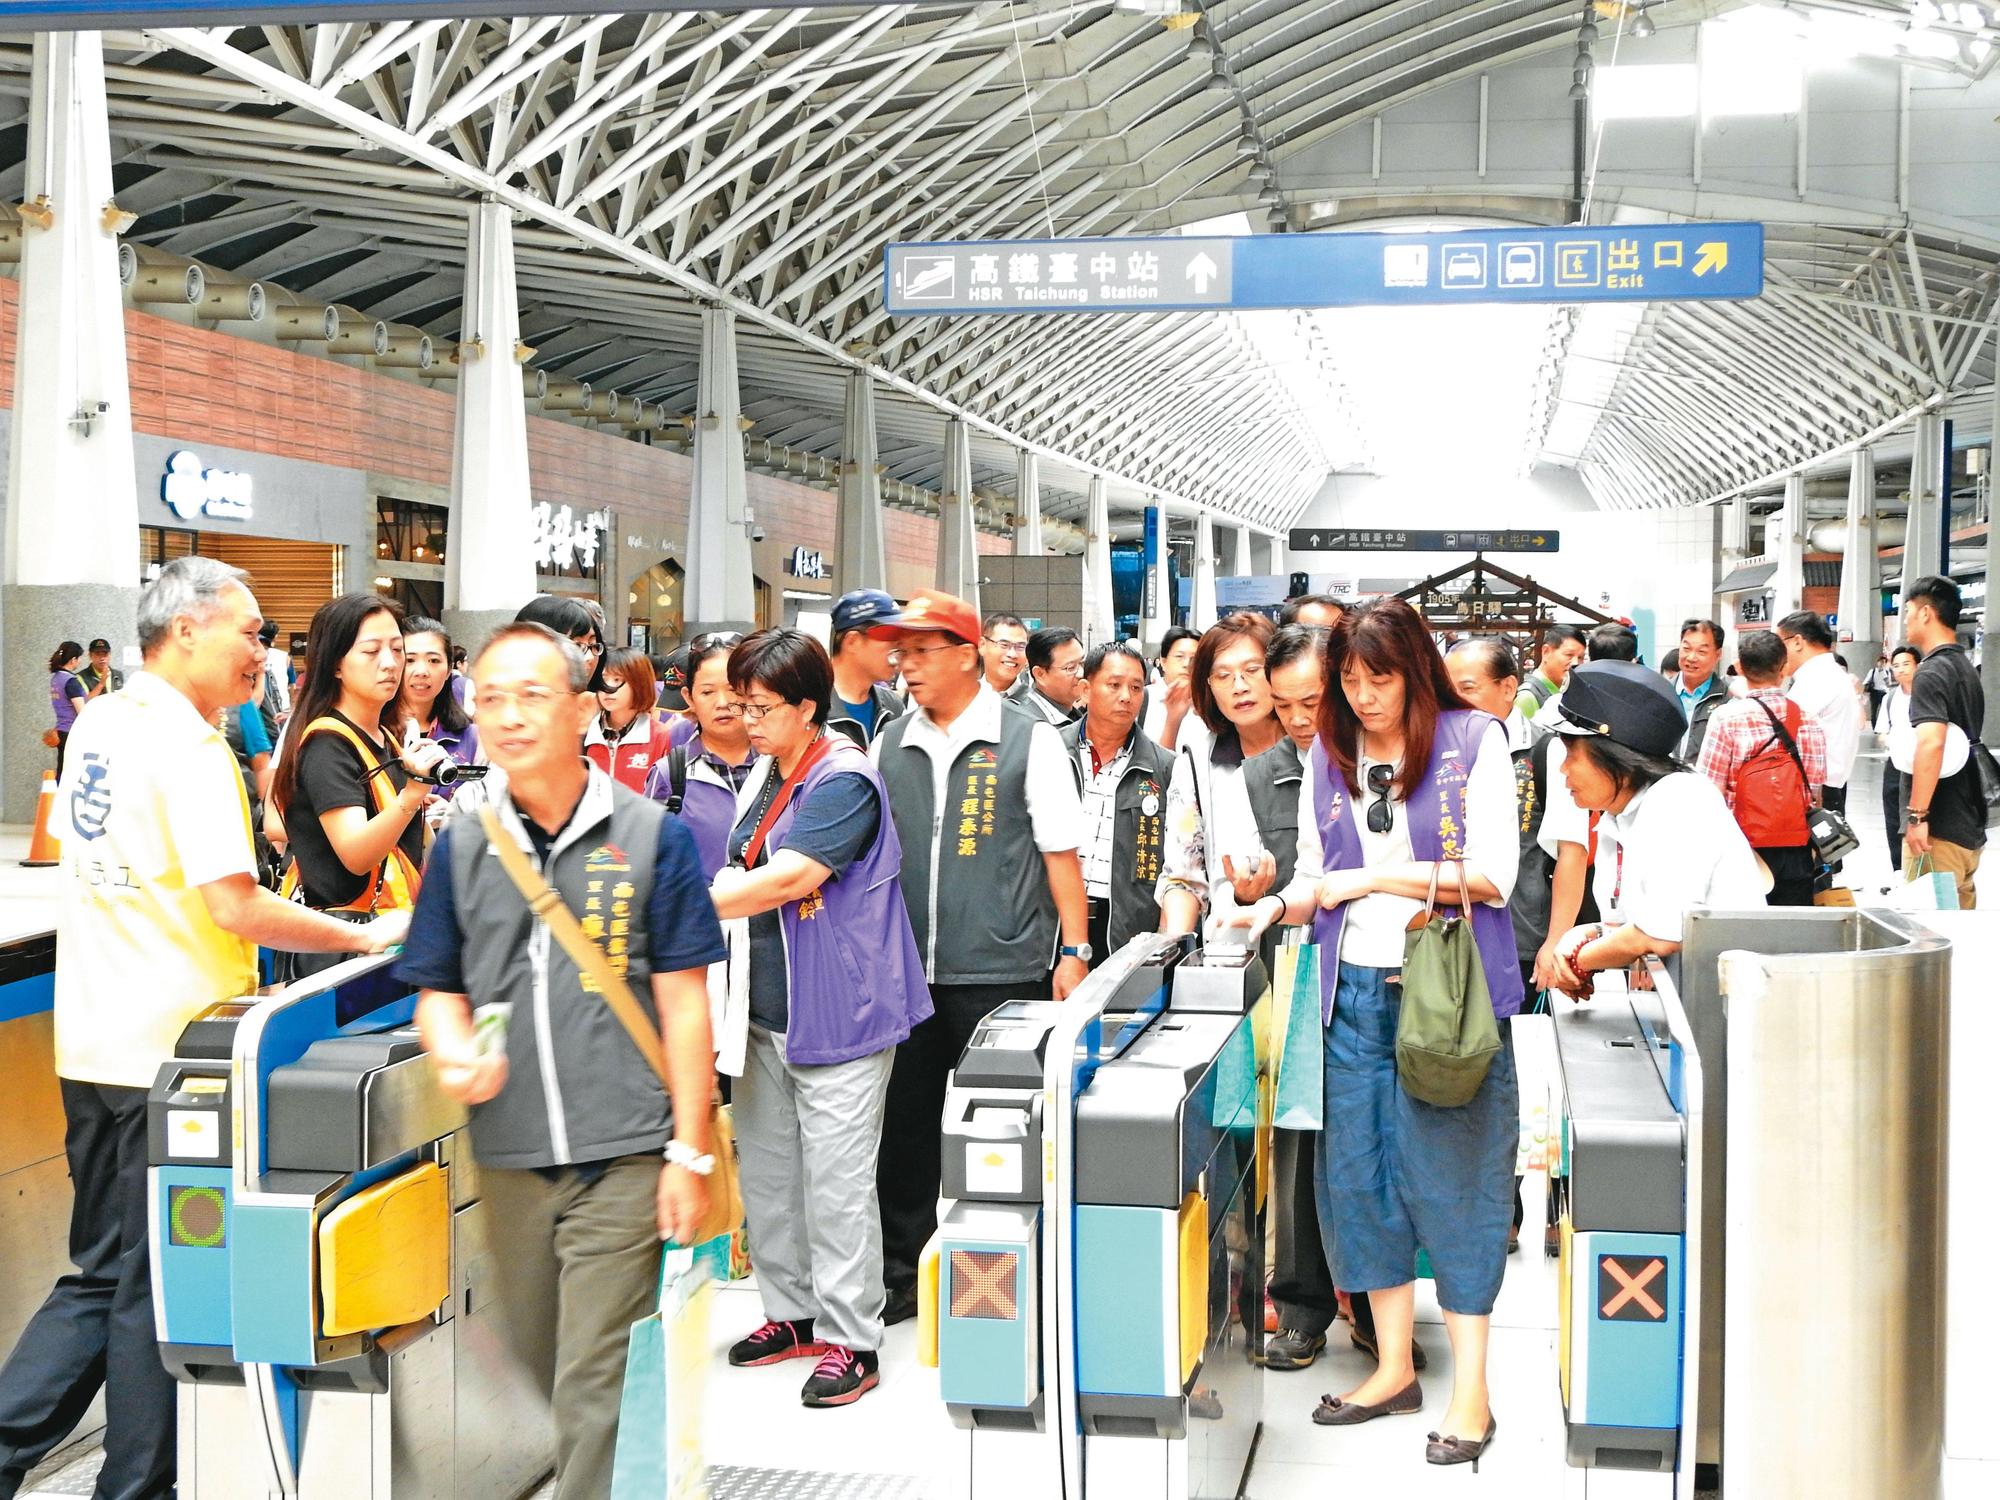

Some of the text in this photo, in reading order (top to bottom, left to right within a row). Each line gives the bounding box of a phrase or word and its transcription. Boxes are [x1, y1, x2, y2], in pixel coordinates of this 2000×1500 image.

[1607, 239, 1683, 271] 出口
[969, 250, 1159, 284] 高鐵臺中站
[1607, 274, 1644, 289] Exit
[968, 285, 1158, 302] HSR Taichung Station
[1427, 594, 1460, 604] 1905年
